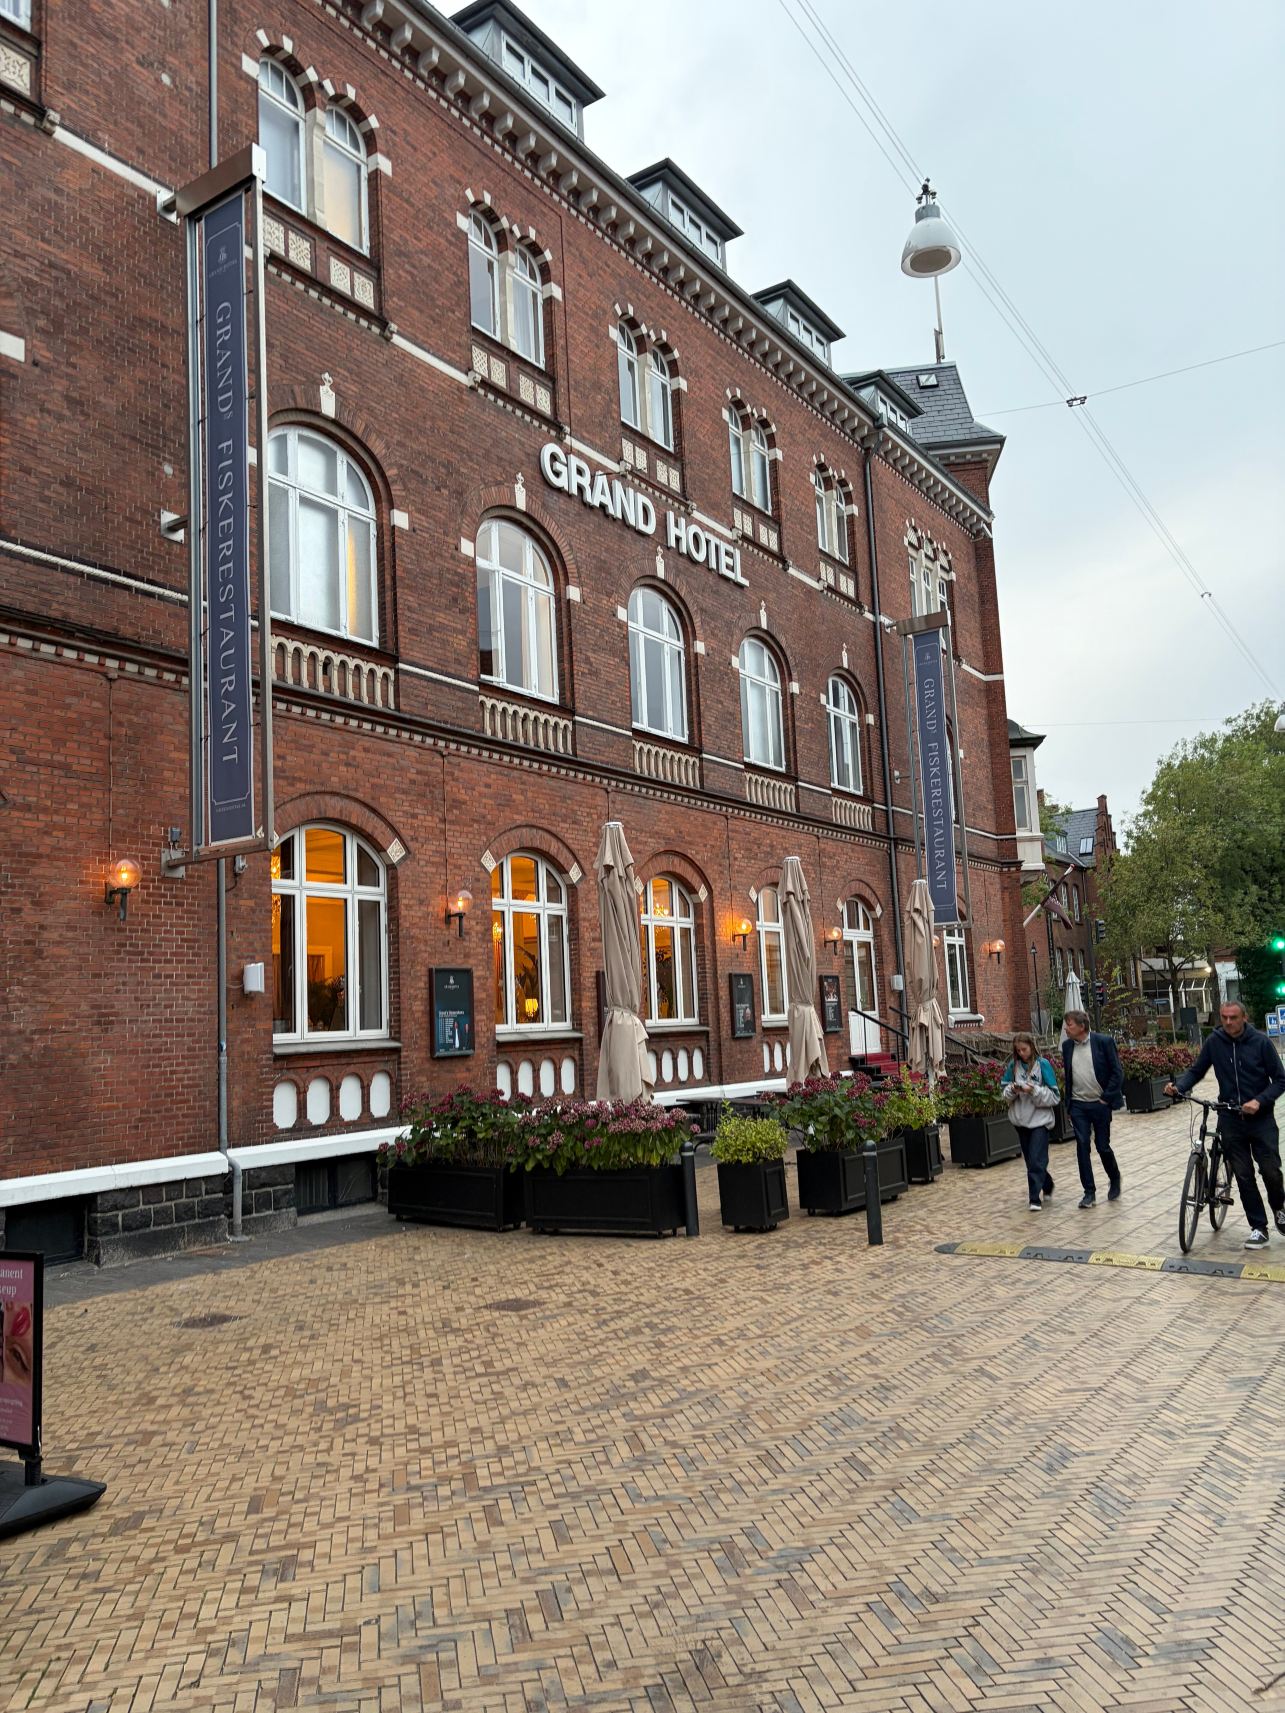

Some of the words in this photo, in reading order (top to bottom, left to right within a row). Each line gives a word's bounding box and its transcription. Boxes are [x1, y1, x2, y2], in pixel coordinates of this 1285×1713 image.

[540, 443, 656, 536] GRAND
[666, 511, 750, 588] HOTEL
[216, 438, 239, 765] FISKERESTAURANT
[928, 742, 947, 889] FISKERESTAURANT
